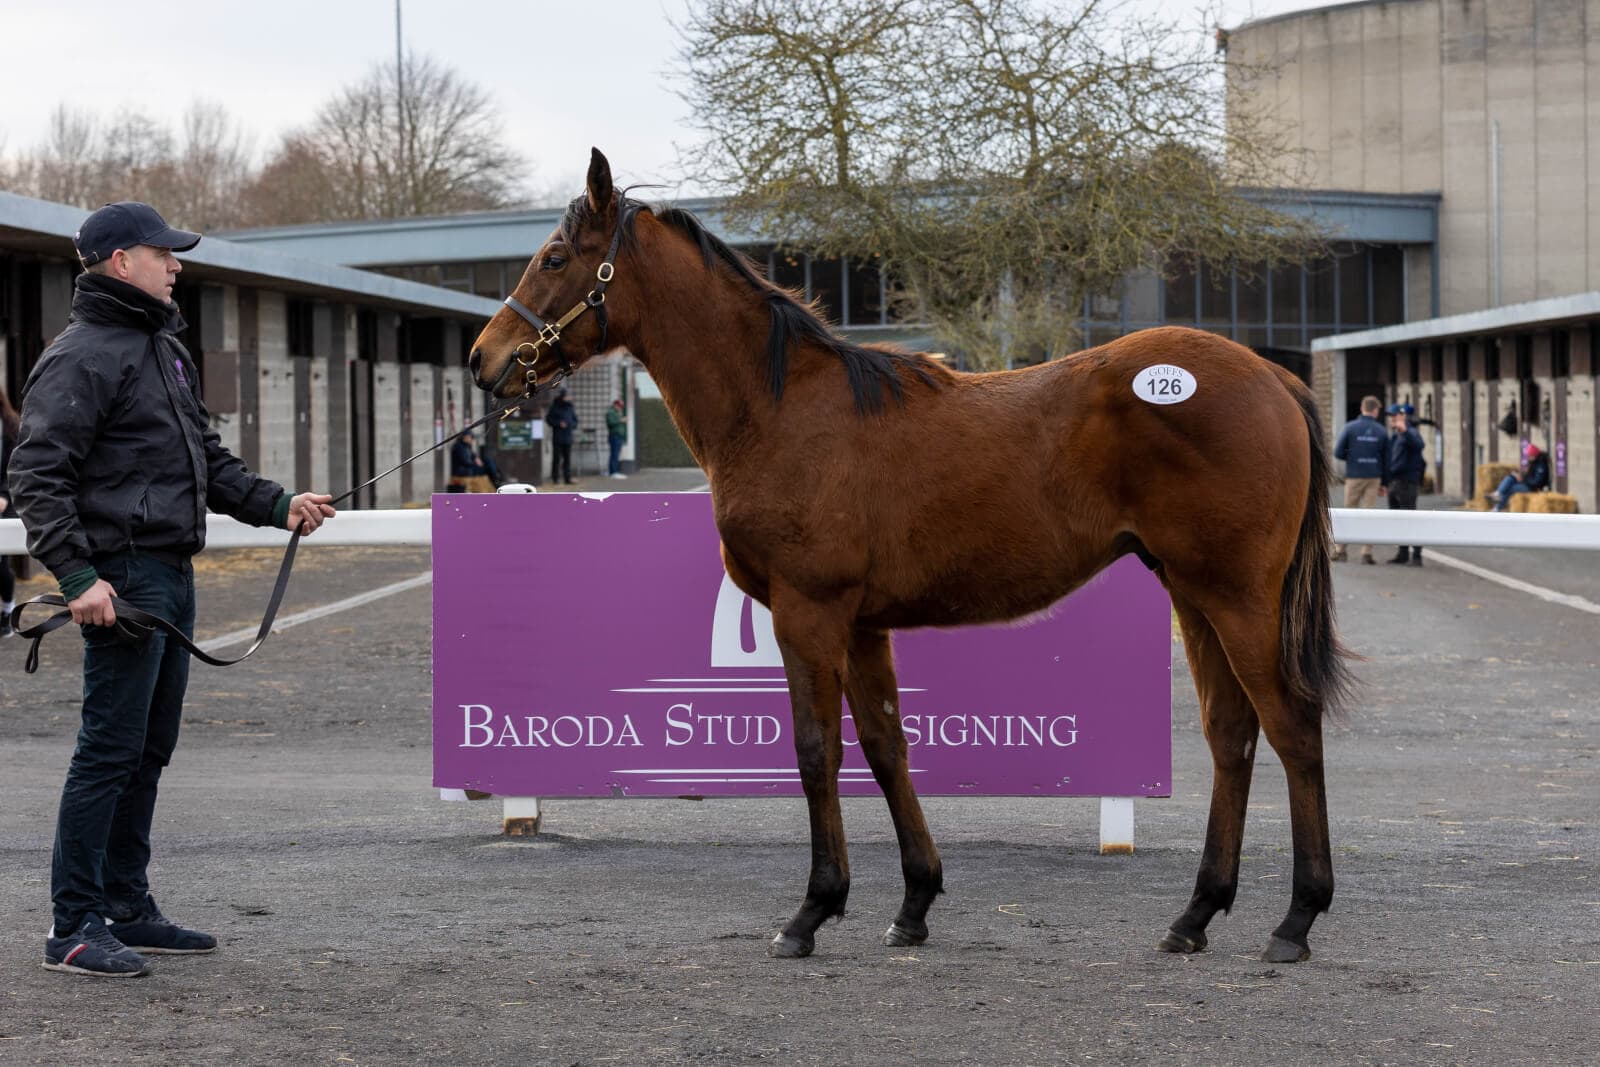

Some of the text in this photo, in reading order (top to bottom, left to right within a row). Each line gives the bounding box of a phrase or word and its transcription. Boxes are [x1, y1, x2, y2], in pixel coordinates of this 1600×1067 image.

[1148, 366, 1184, 378] GOFFS
[1147, 378, 1182, 396] 126
[841, 713, 1079, 747] SIGNING
